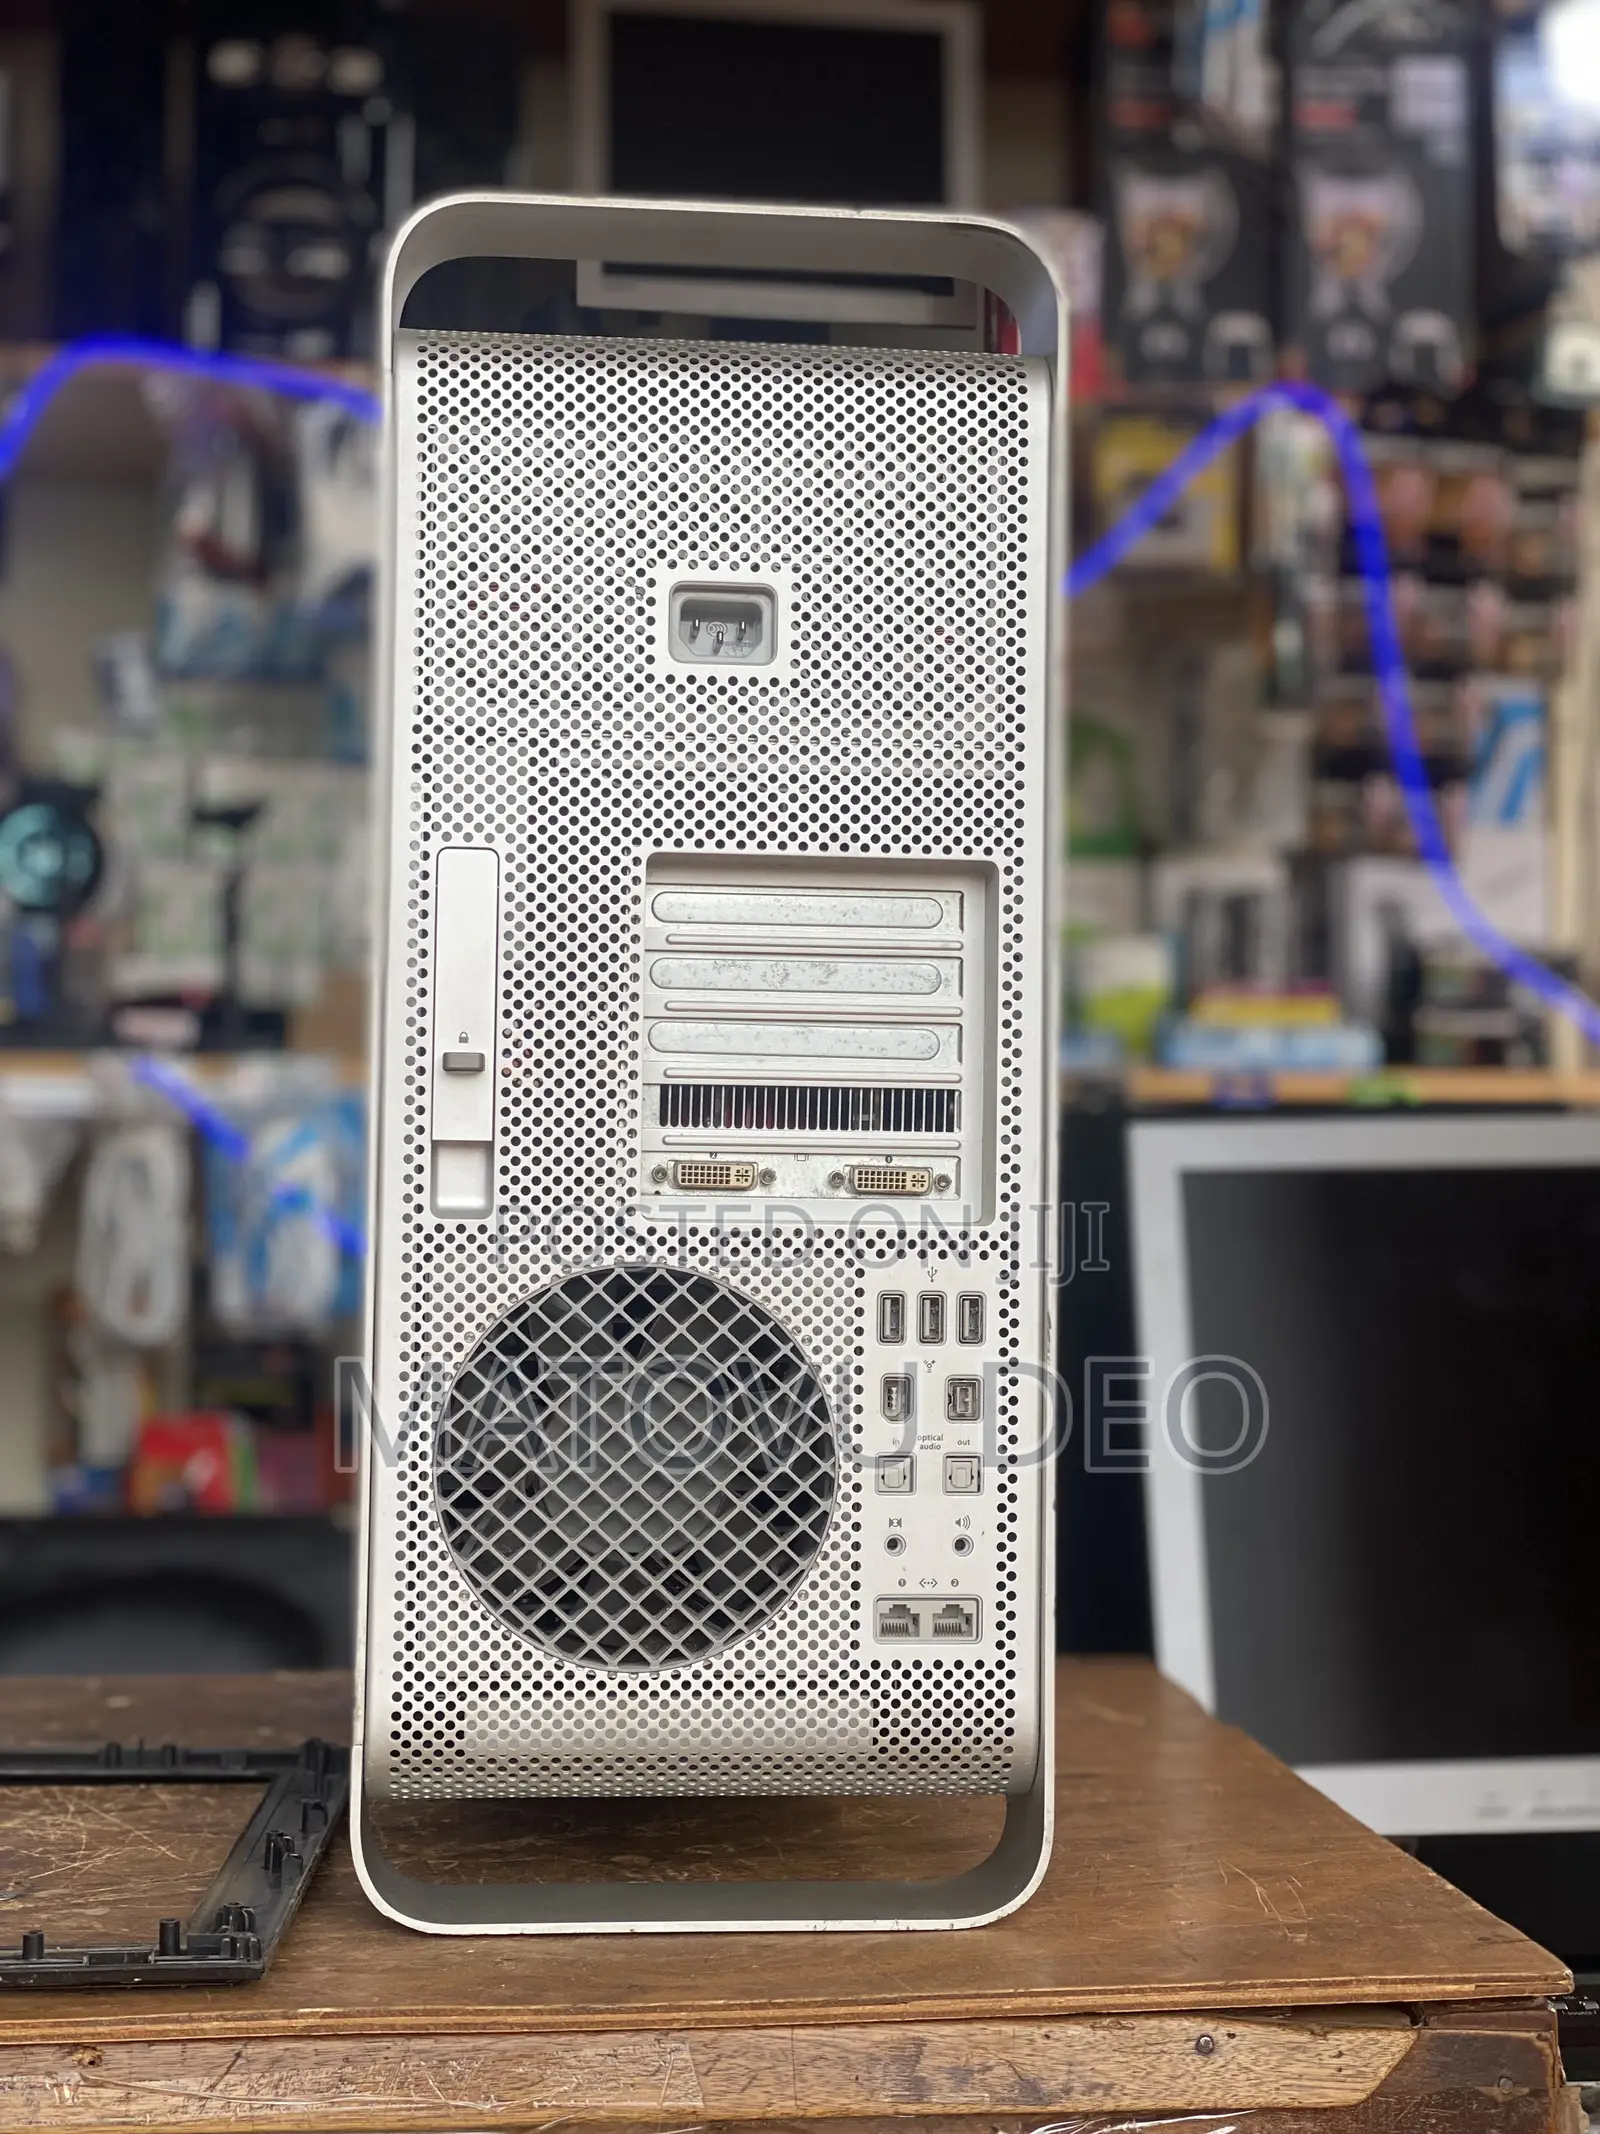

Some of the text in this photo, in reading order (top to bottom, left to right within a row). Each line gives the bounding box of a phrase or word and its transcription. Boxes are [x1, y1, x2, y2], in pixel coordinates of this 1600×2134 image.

[892, 1437, 900, 1446] in
[917, 1433, 944, 1443] optical
[919, 1443, 941, 1451] audio
